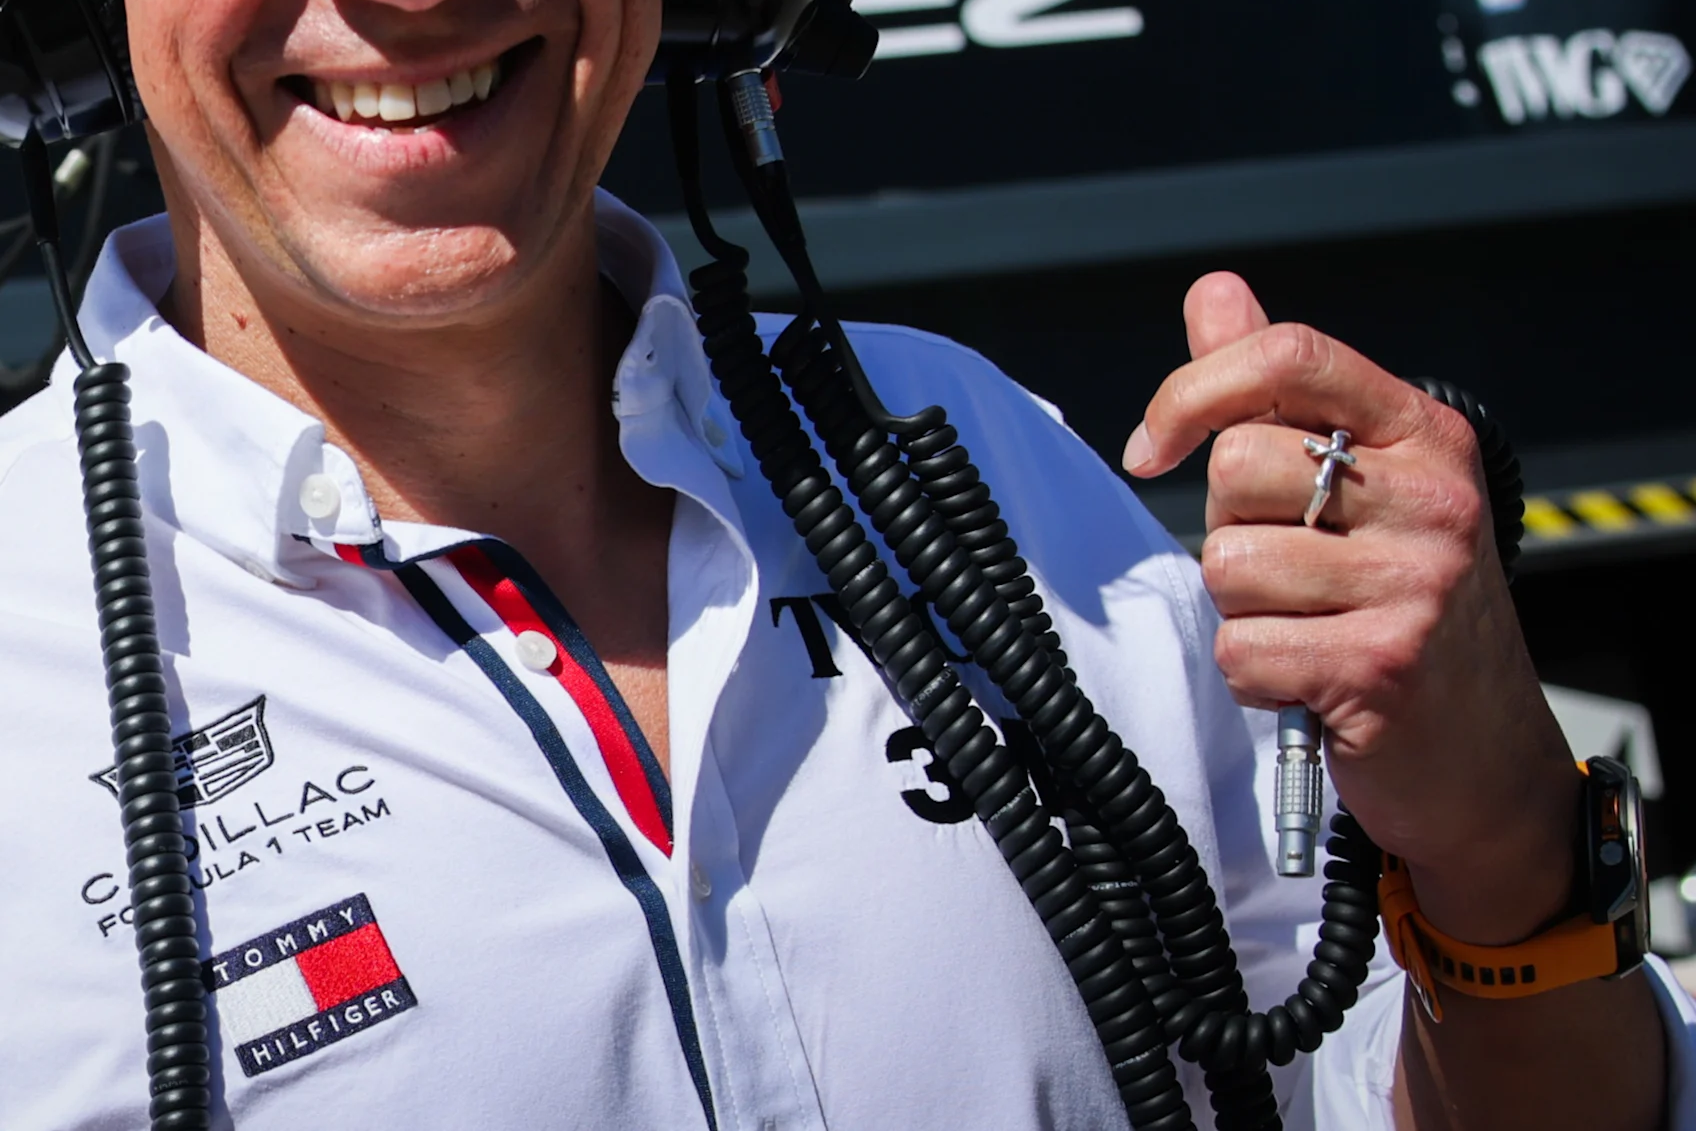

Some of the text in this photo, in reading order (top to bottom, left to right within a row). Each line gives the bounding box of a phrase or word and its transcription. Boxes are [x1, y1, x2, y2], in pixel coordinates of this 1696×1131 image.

[81, 766, 375, 905] CILLAC
[266, 836, 284, 855] 1
[293, 798, 392, 844] TEAM
[213, 907, 355, 981] TOMMY
[251, 989, 401, 1067] HILFIGER
